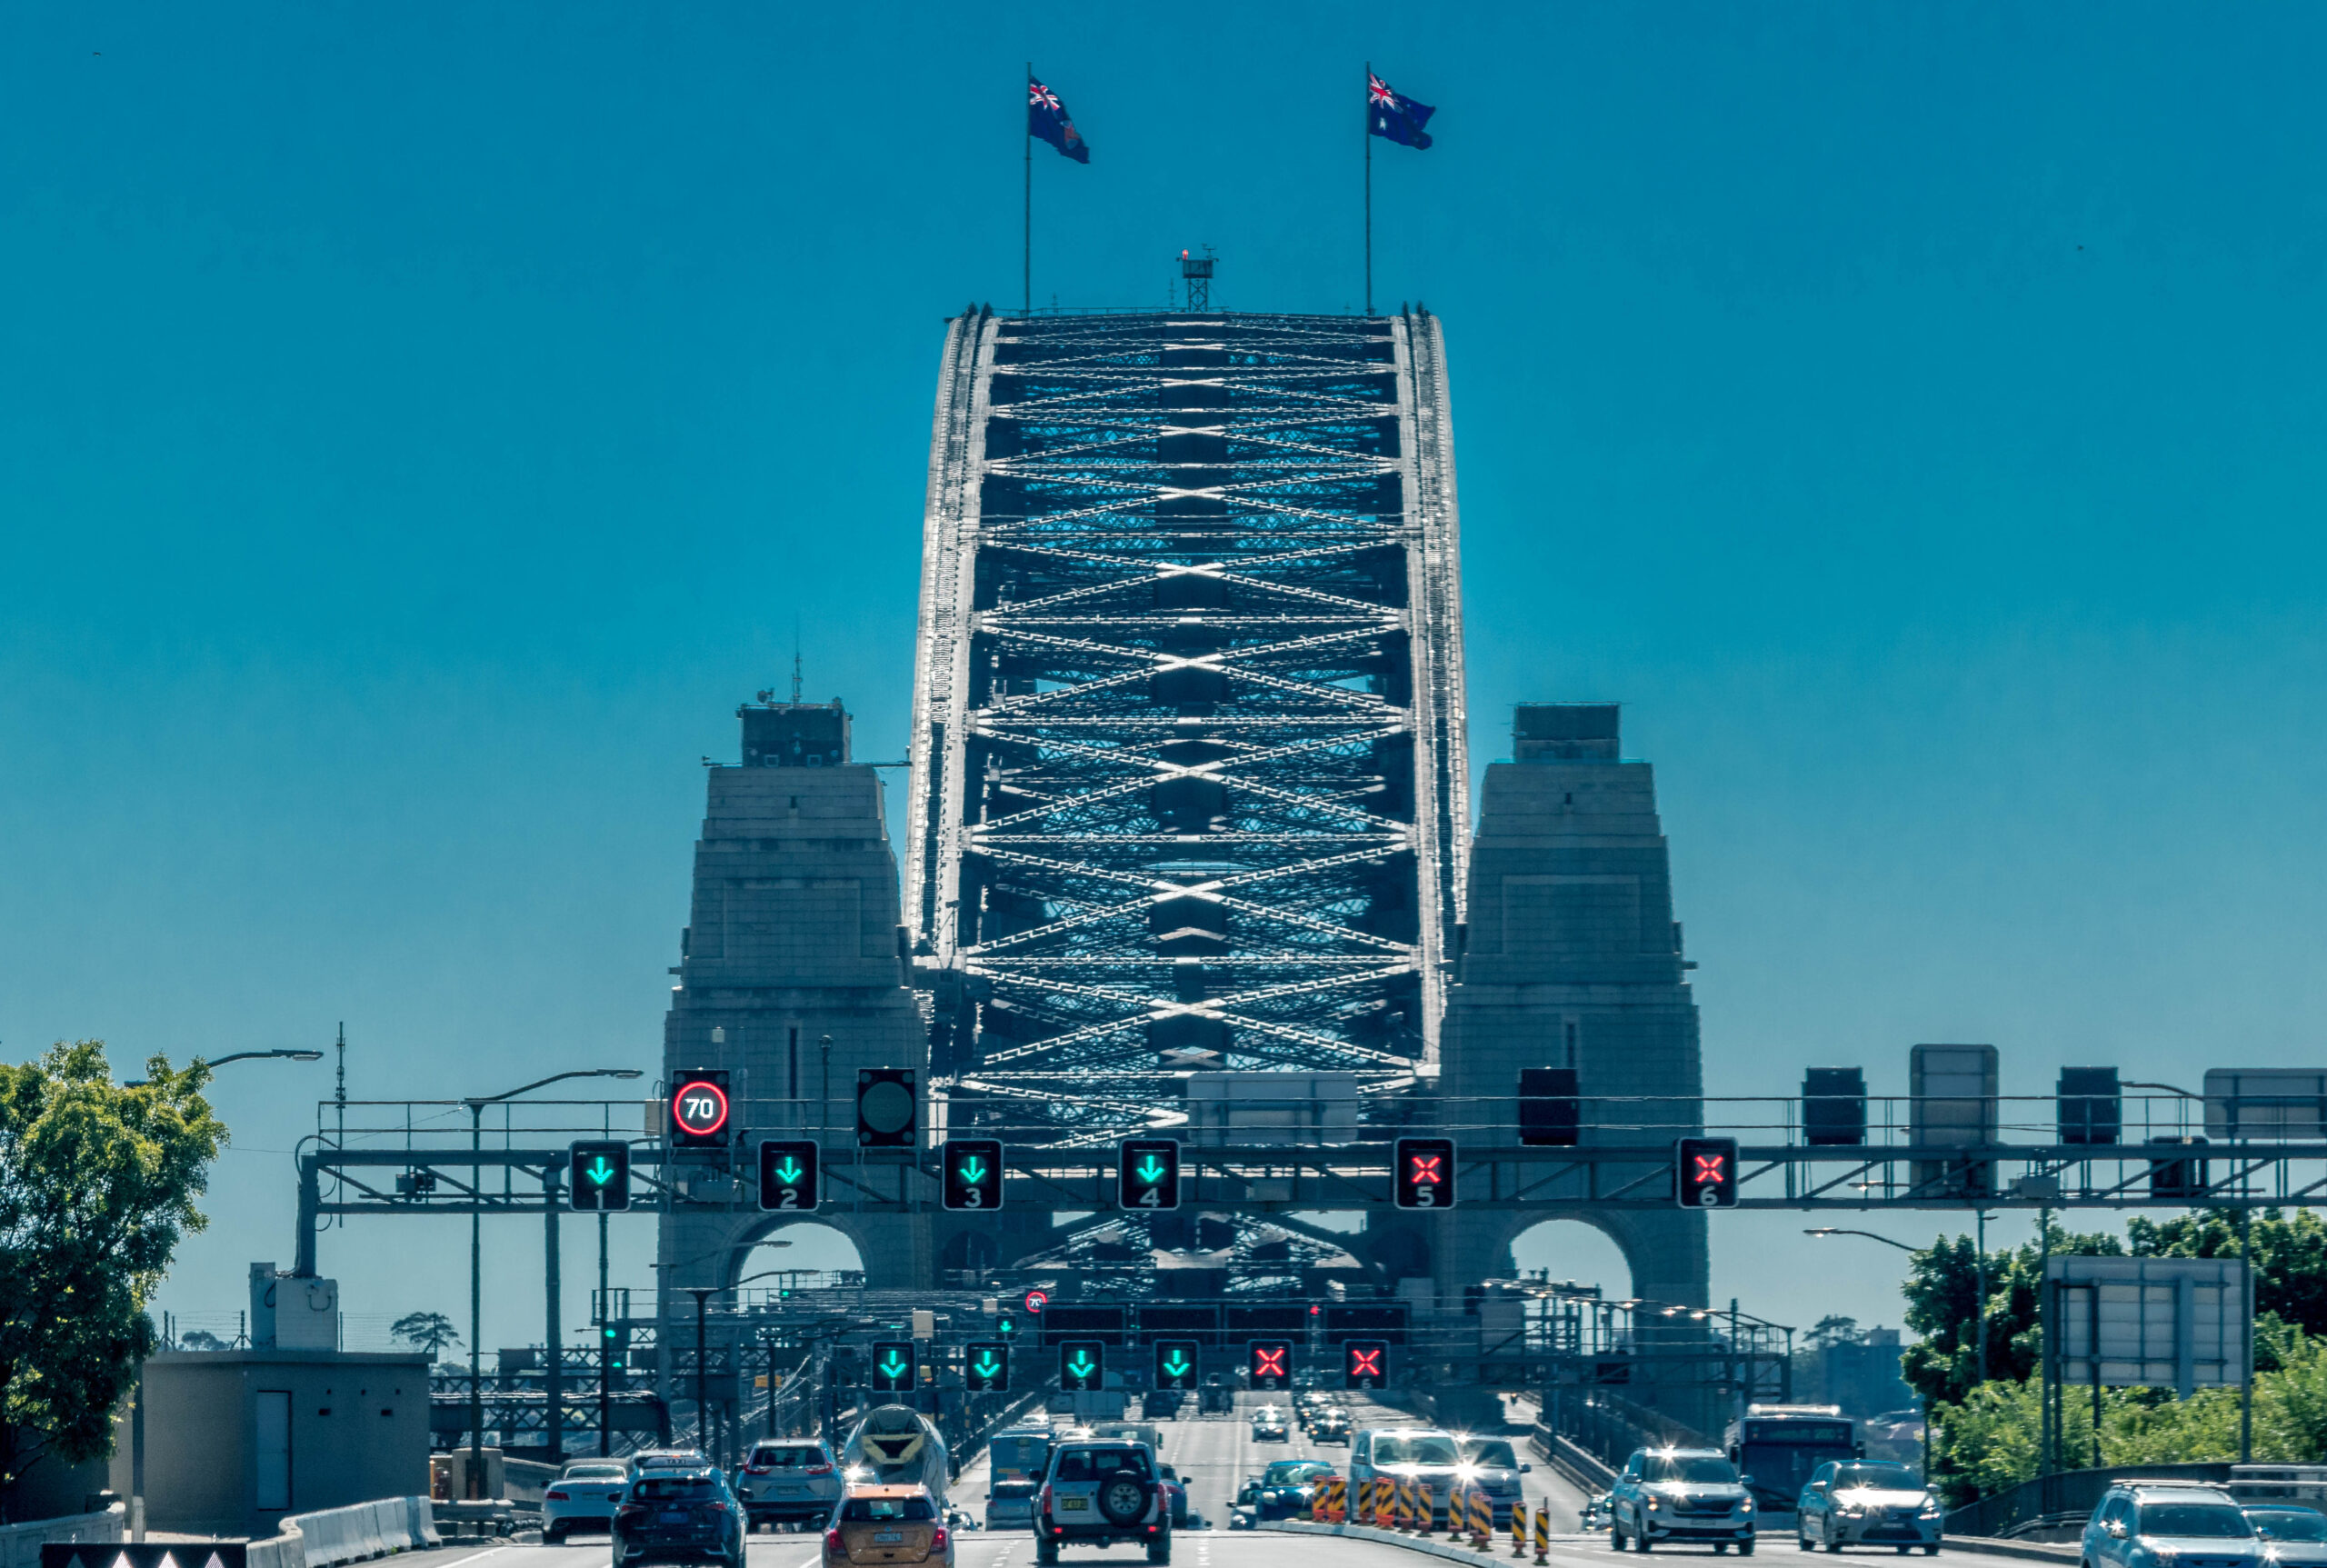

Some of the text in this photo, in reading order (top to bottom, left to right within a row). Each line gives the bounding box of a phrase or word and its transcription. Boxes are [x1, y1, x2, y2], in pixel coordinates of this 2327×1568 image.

[684, 1098, 714, 1119] 70
[594, 1189, 604, 1209] 1
[780, 1188, 798, 1209] 2
[964, 1187, 982, 1208] 3
[1140, 1187, 1160, 1207] 4
[1417, 1186, 1435, 1206] 5
[1700, 1185, 1718, 1206] 6
[891, 1380, 895, 1390] 1
[983, 1380, 993, 1391] 2
[1077, 1380, 1086, 1391] 3
[1171, 1379, 1182, 1389] 4
[1266, 1379, 1275, 1389] 5
[1362, 1379, 1372, 1389] 6
